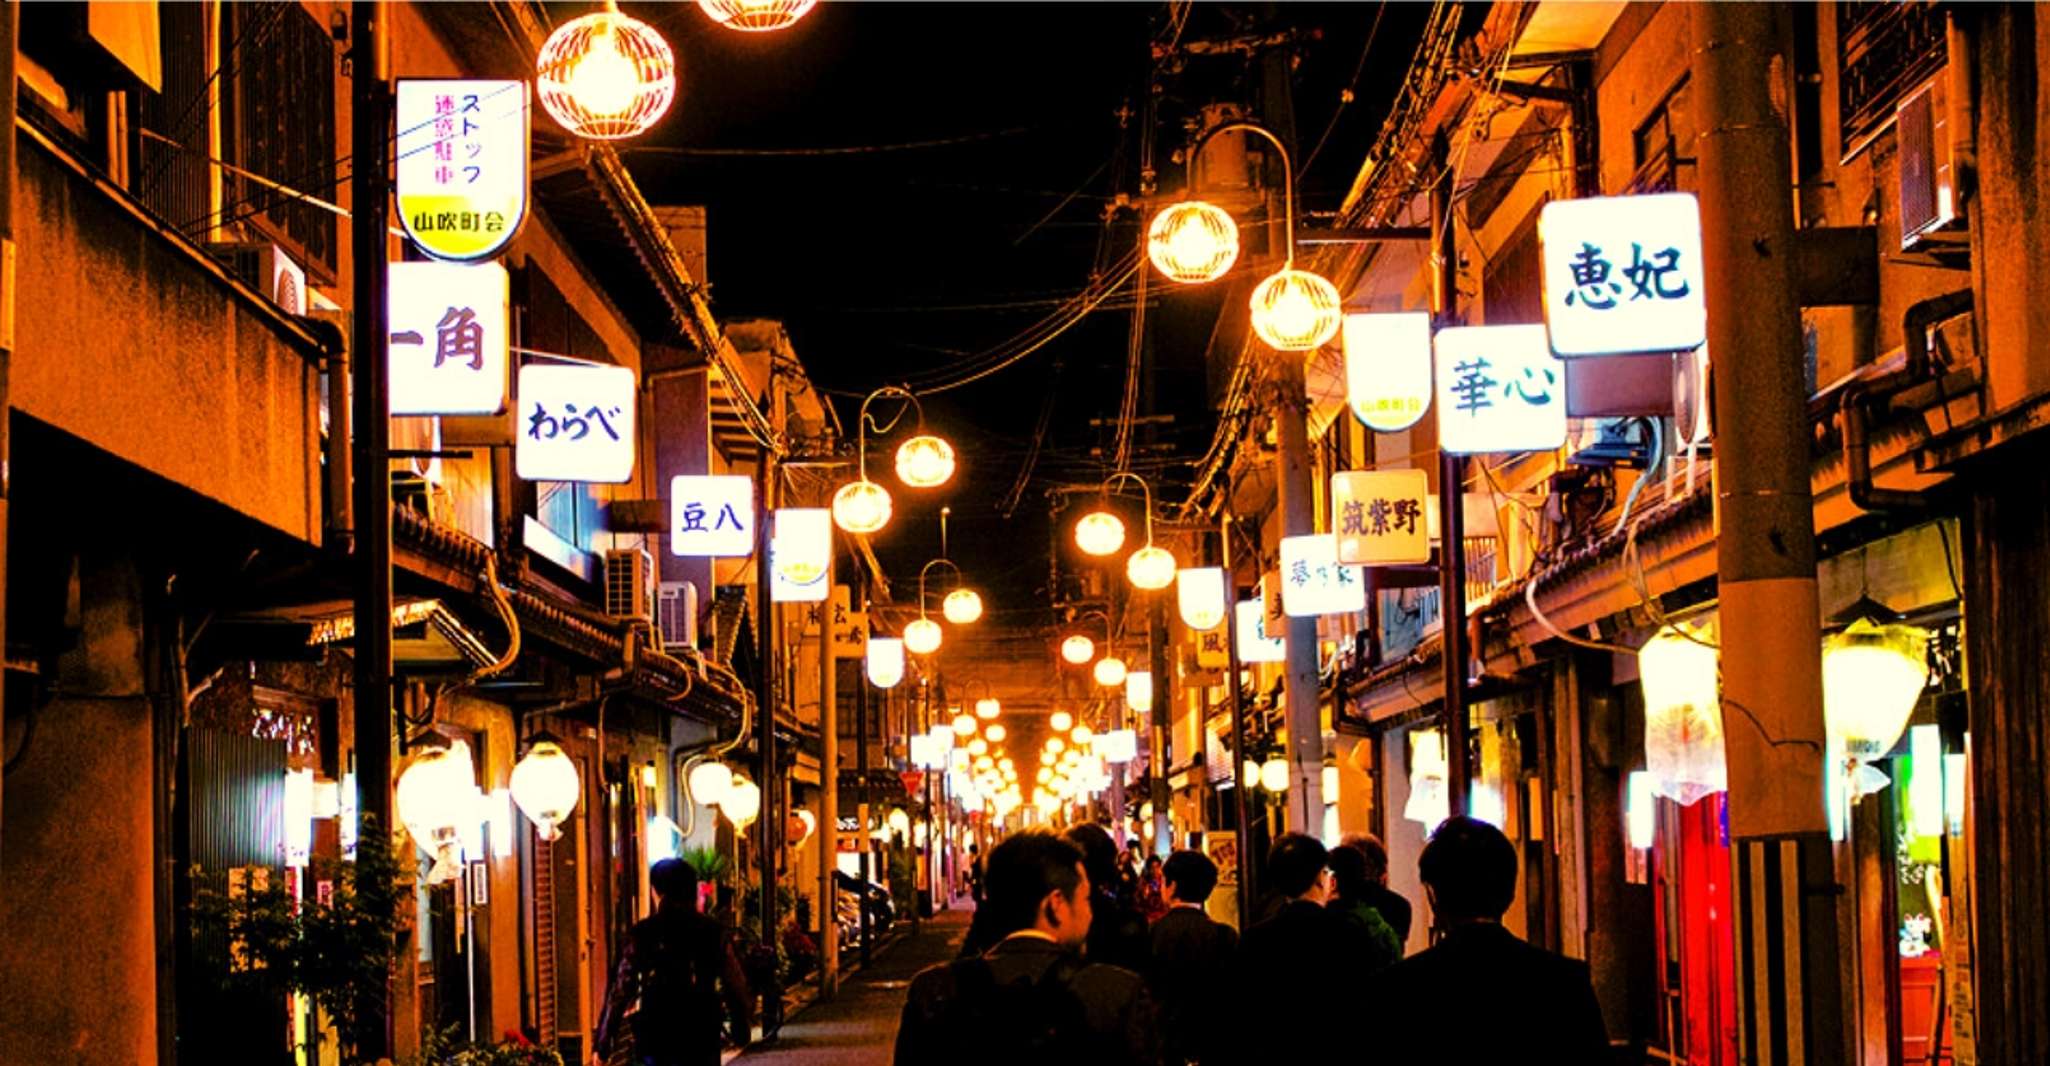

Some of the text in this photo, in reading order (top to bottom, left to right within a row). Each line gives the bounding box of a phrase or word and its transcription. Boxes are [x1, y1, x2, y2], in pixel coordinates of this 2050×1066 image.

[414, 211, 504, 232] 山吹町会
[1564, 241, 1690, 310] 恵妃
[390, 305, 484, 371] 一角
[1450, 356, 1555, 418] 華心
[528, 401, 623, 442] わらべ
[681, 501, 744, 533] 豆八
[1342, 498, 1422, 536] 筑紫野
